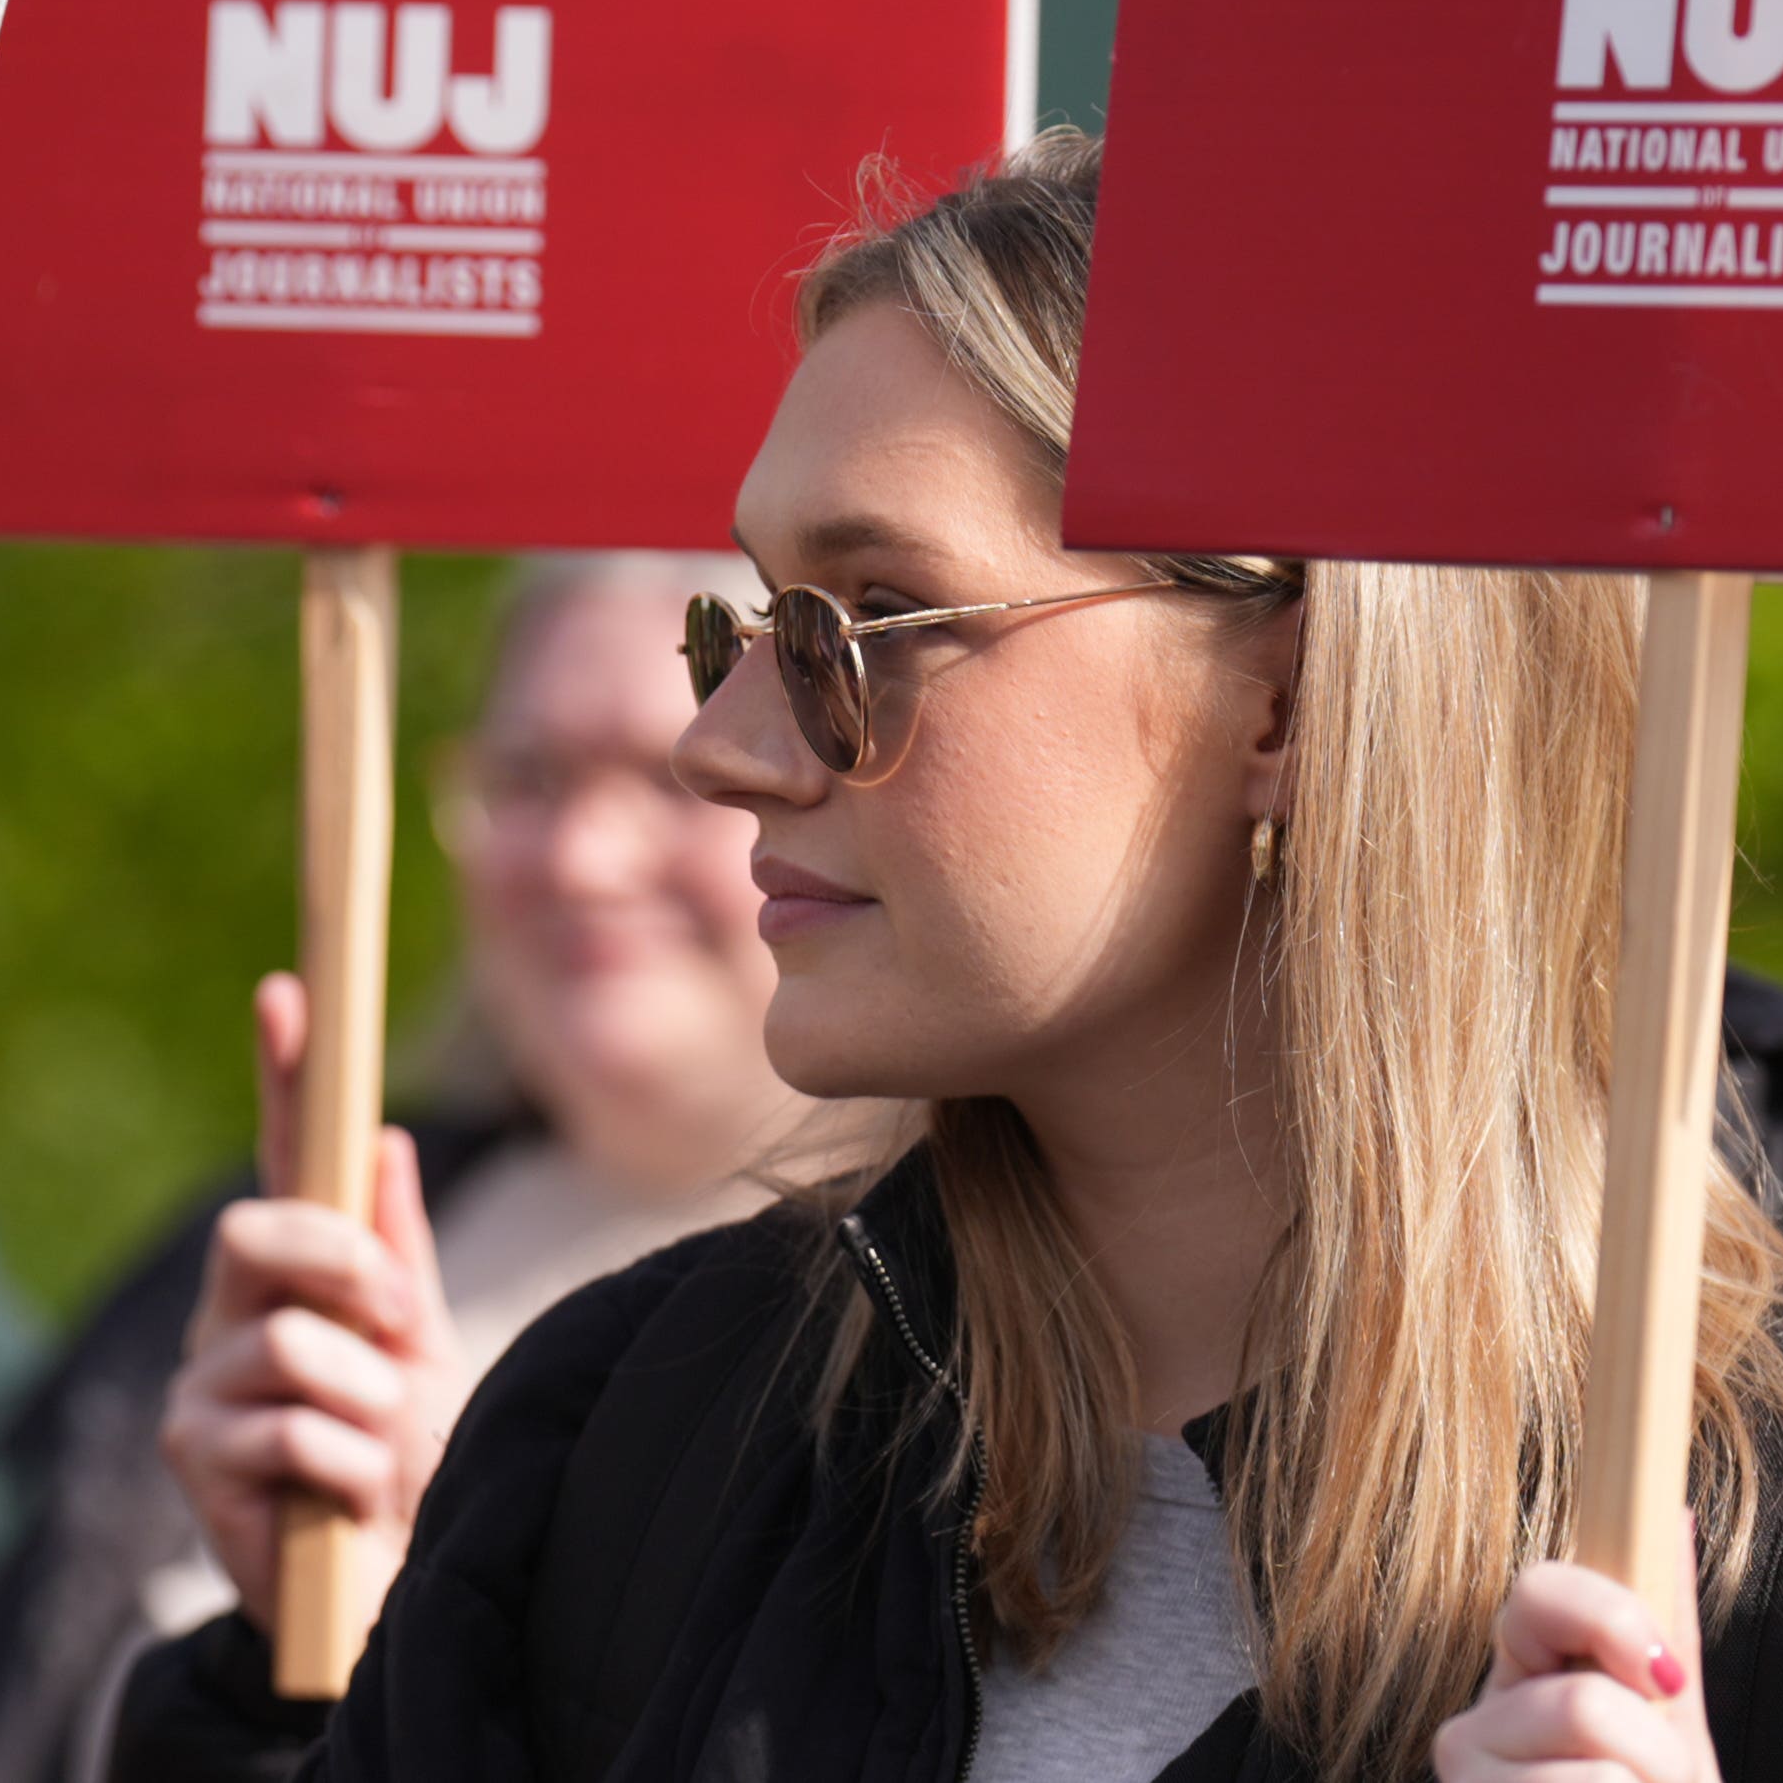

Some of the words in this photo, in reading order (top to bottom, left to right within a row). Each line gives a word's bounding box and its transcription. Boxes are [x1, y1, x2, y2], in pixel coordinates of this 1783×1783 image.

[1549, 127, 1746, 172] NATIONAL
[203, 171, 405, 219] NATIONAL
[413, 178, 546, 224] UNION
[198, 250, 541, 310] JOURNALISTS
